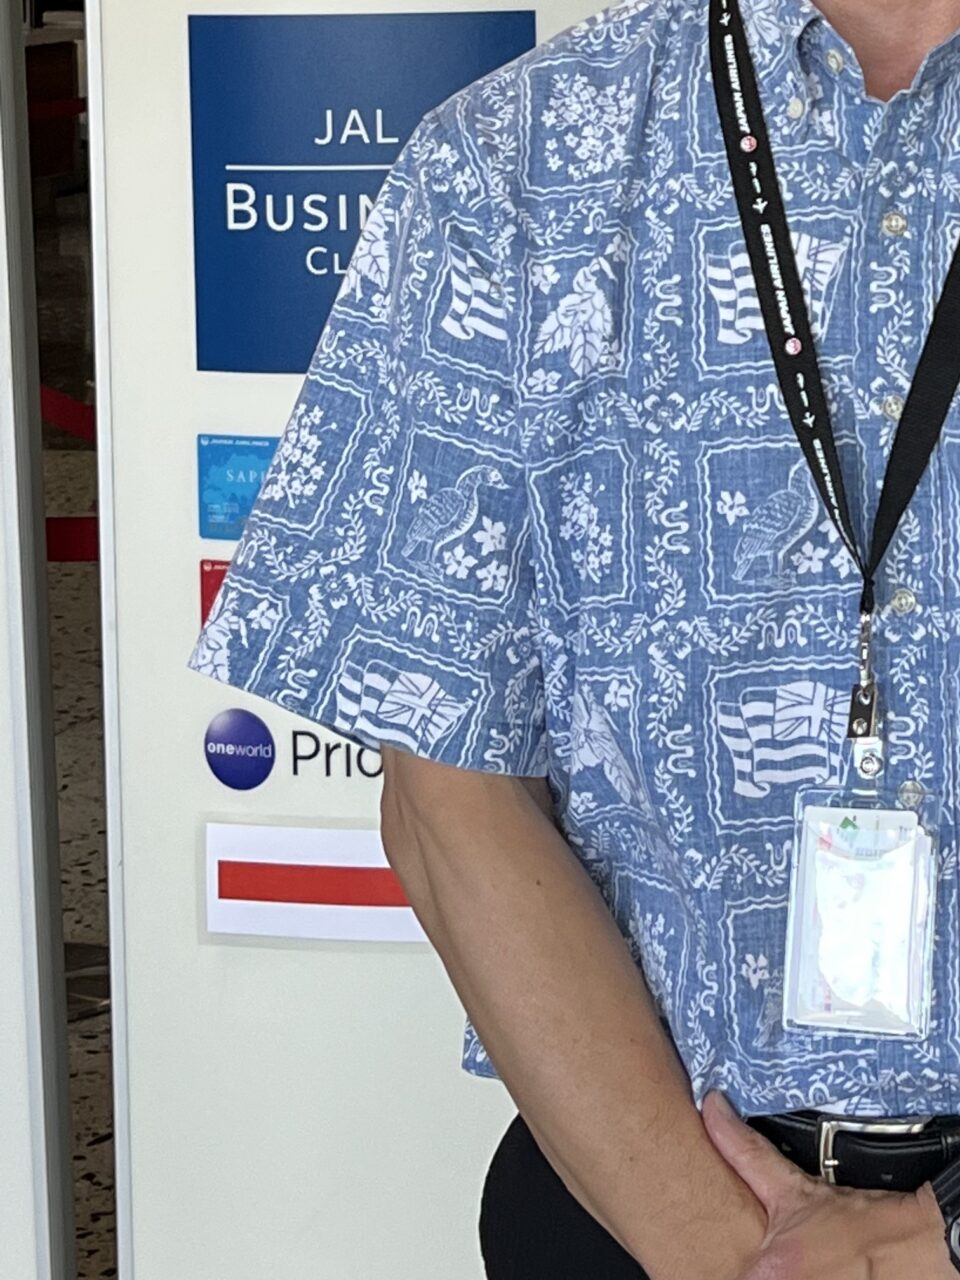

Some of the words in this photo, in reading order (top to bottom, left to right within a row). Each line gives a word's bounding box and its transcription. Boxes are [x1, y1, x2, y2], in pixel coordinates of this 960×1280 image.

[724, 33, 742, 91] AIRLINES
[314, 108, 400, 146] JAL
[733, 91, 751, 134] JAPAN
[760, 223, 785, 289] AIRLINES
[775, 290, 796, 335] JAPAN
[207, 741, 273, 759] oneworld
